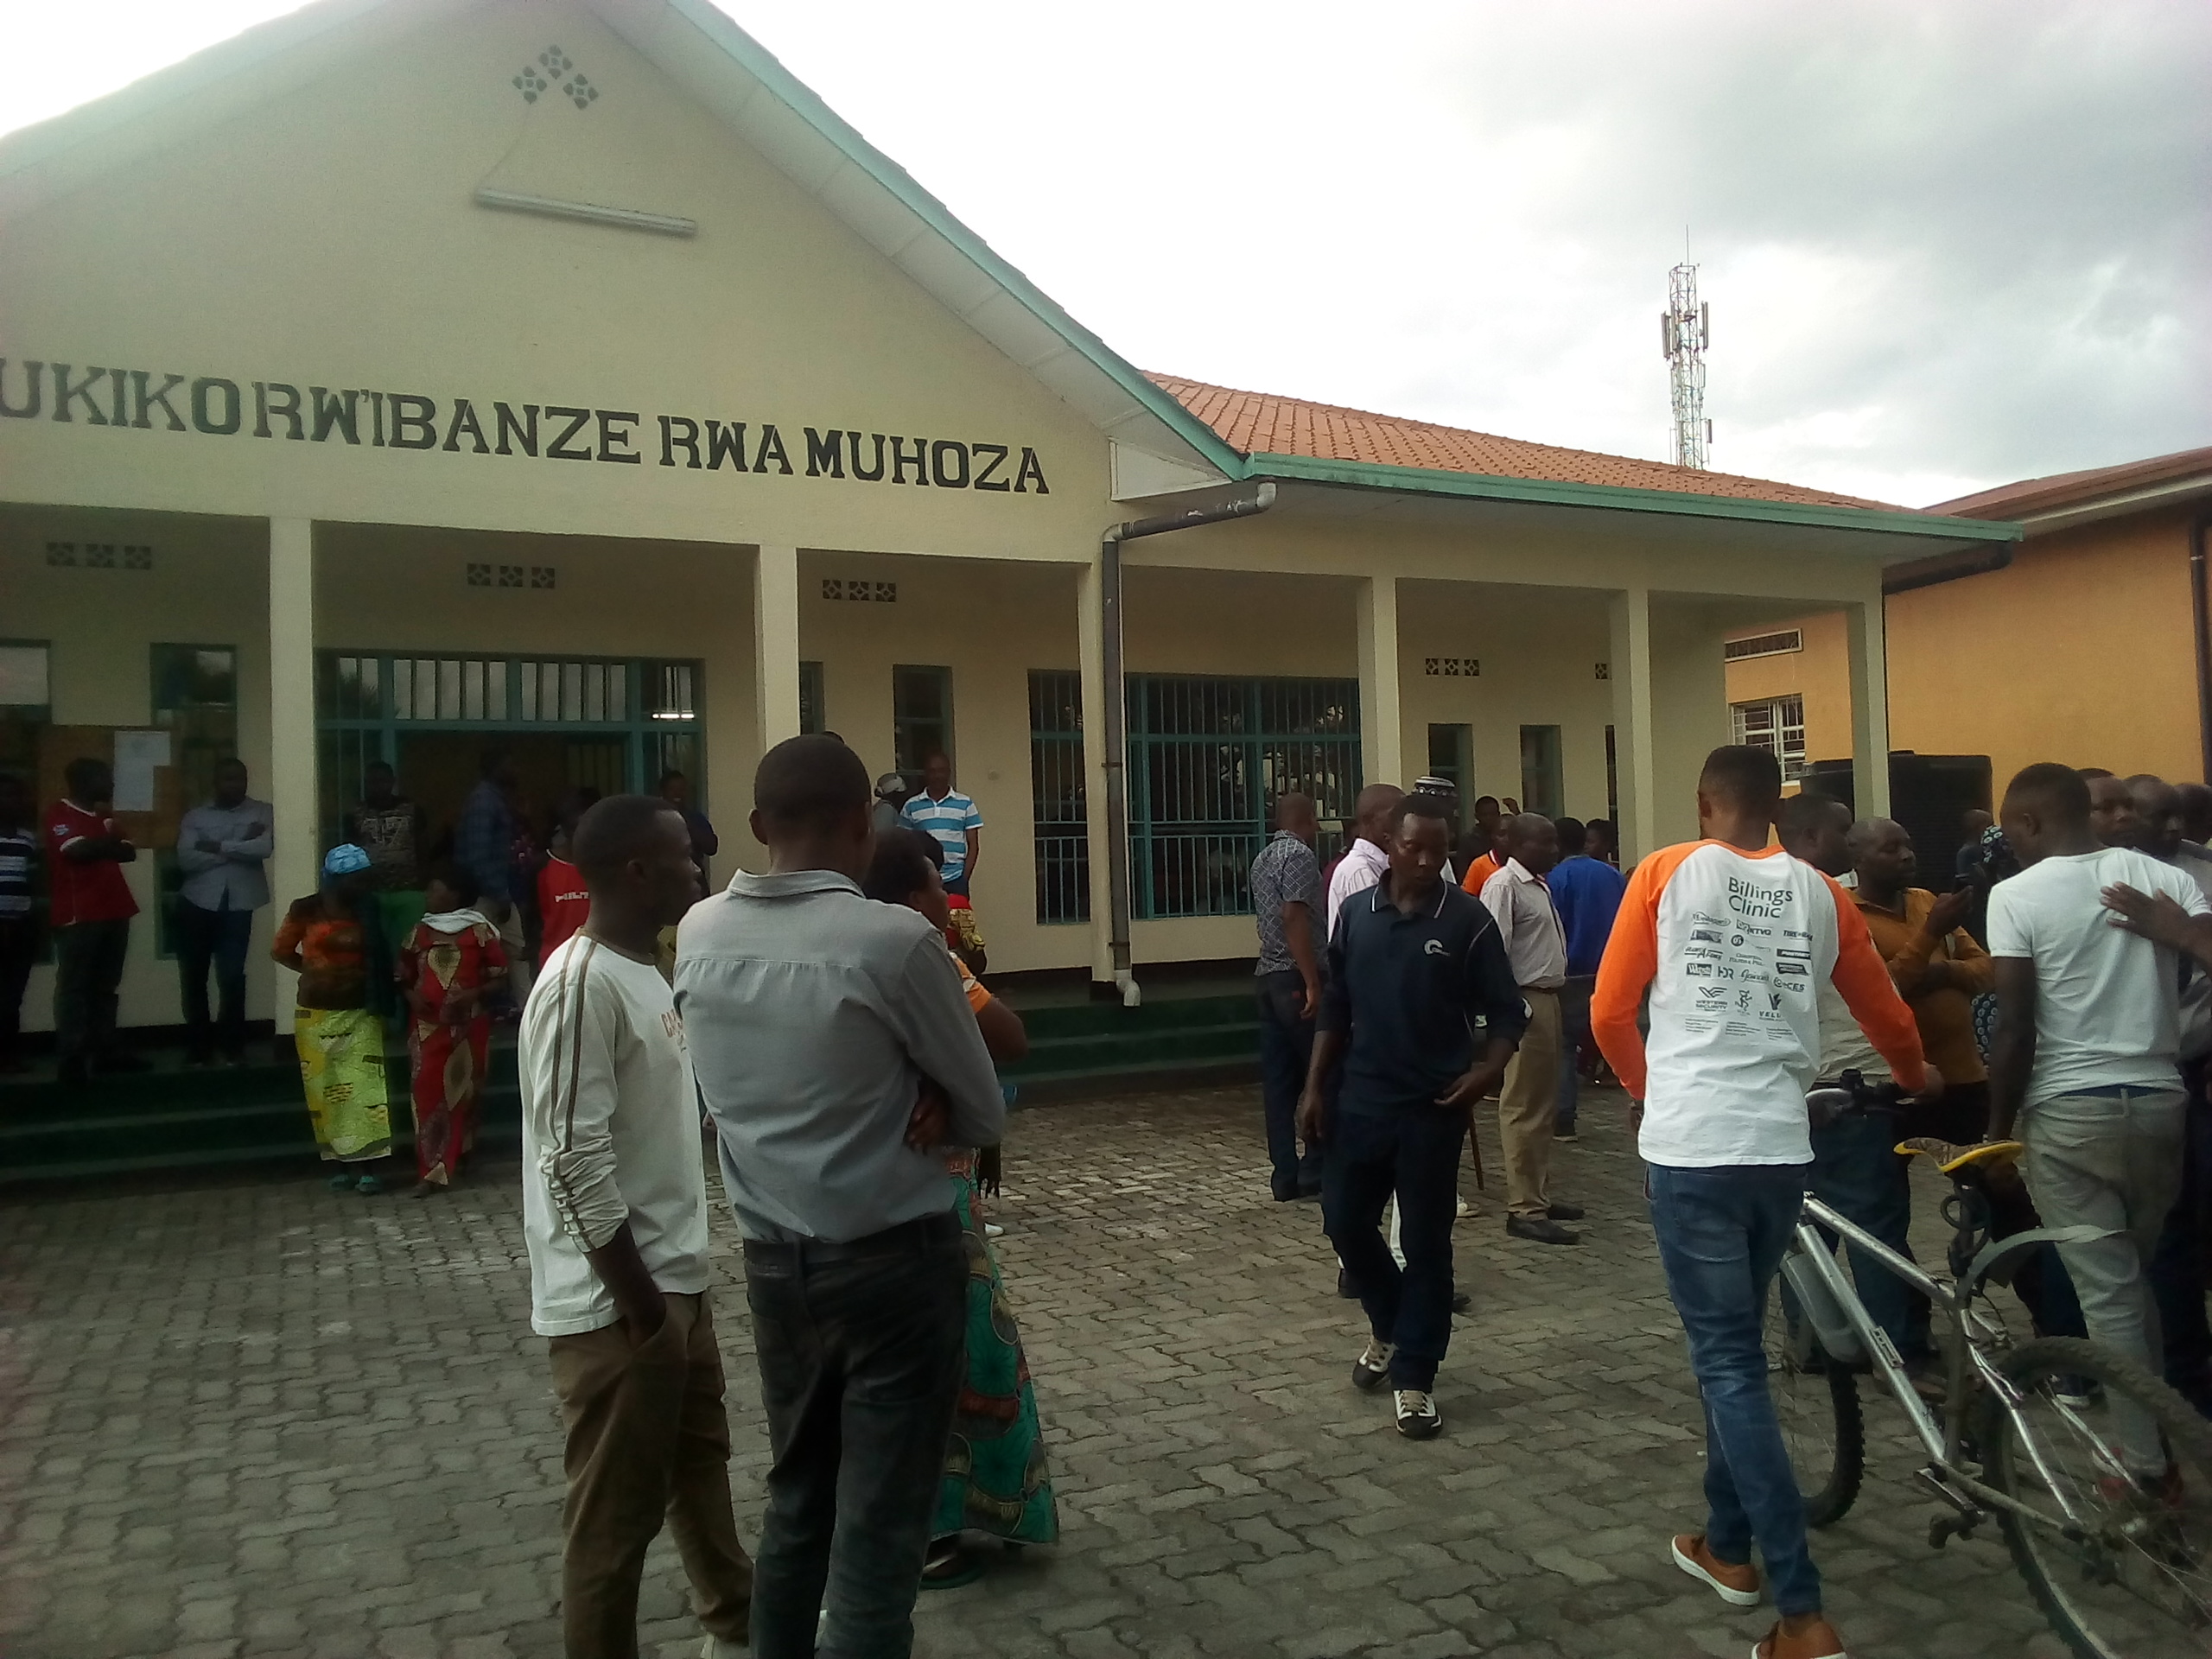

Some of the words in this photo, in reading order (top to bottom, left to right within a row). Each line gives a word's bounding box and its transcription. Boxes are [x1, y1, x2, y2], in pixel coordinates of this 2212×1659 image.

[0, 358, 240, 435] UKIKO
[658, 415, 793, 475] RWA
[804, 427, 1049, 494] MUHOZA
[1729, 876, 1793, 906] Billings
[1729, 894, 1782, 918] Clinic
